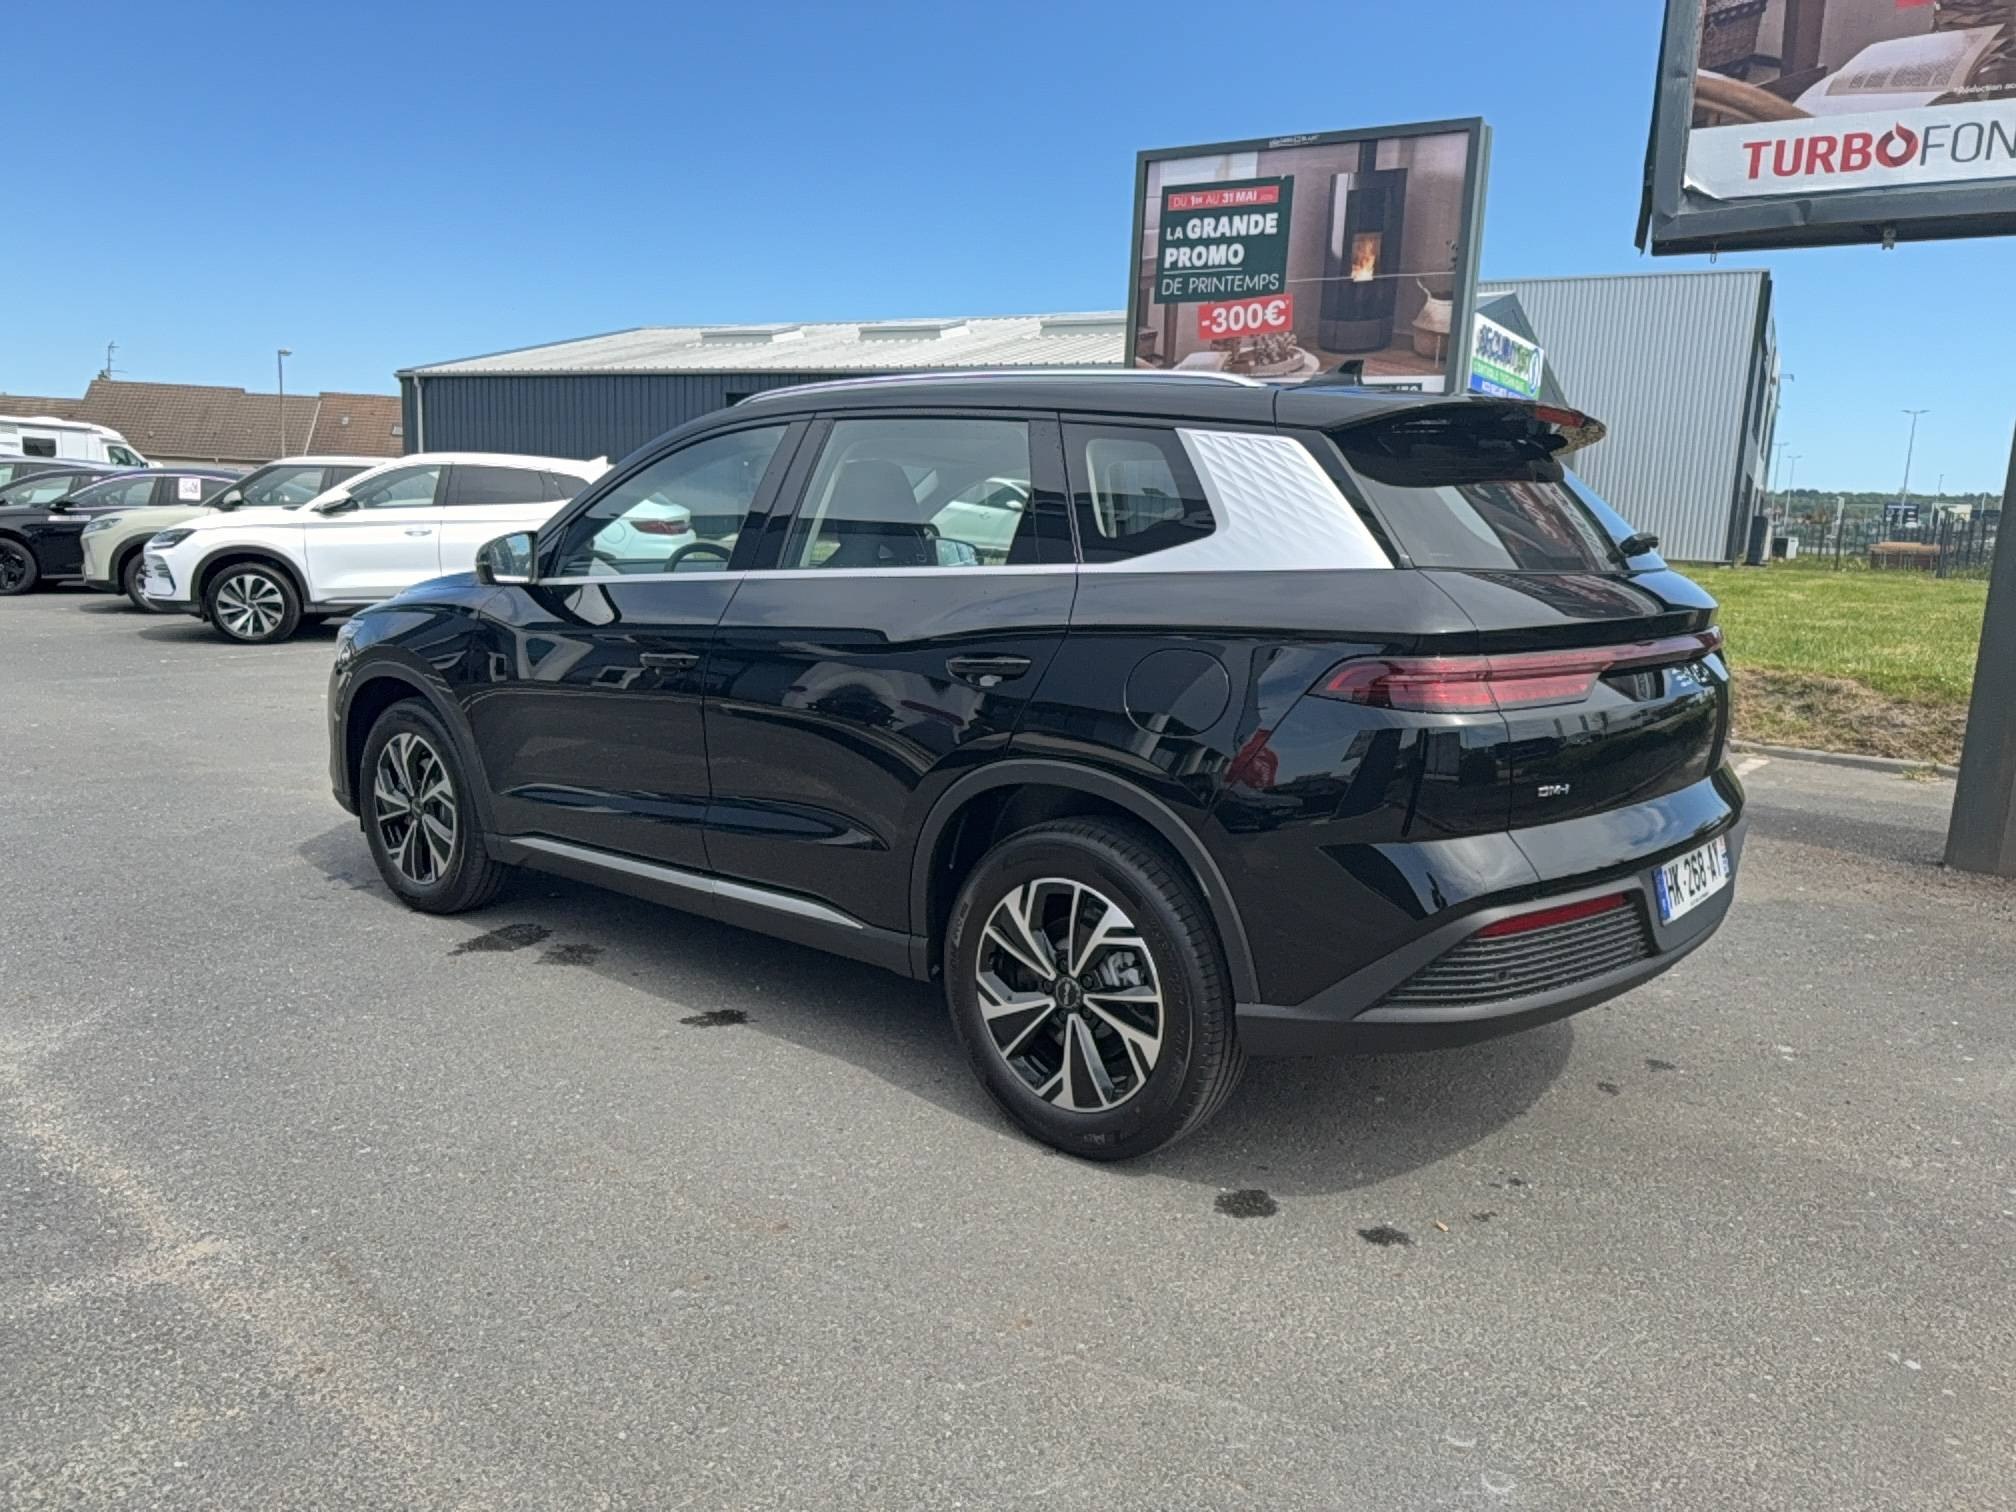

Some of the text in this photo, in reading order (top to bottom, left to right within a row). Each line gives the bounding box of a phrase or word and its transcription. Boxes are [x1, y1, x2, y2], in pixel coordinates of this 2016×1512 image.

[1173, 196, 1187, 208] DU
[1205, 193, 1221, 205] AU
[1221, 191, 1233, 204] 31
[1234, 190, 1258, 203] MAI
[1165, 212, 1279, 241] LA GRANDE
[1164, 243, 1245, 269] PROMO
[1161, 273, 1280, 295] DE PRINTEMPS
